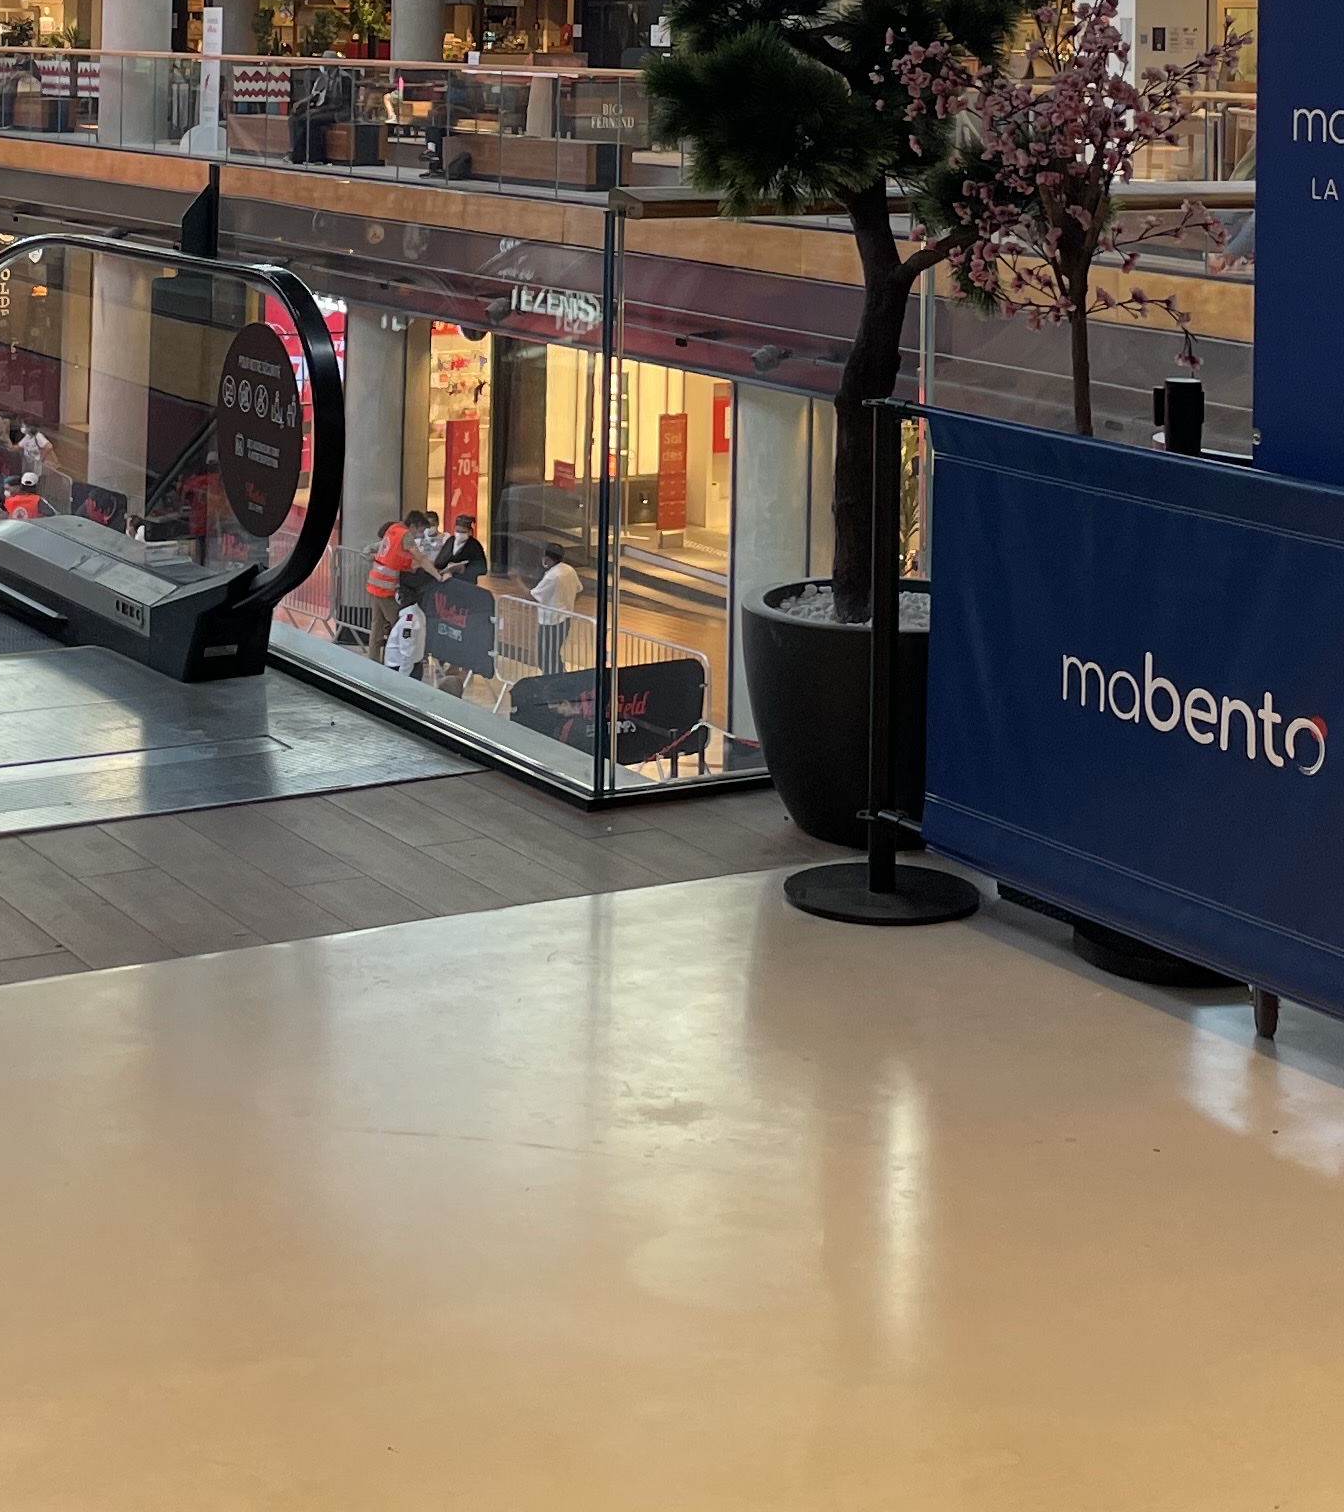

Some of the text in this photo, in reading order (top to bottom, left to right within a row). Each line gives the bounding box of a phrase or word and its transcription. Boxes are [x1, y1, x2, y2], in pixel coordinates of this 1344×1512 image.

[602, 103, 624, 116] BIG
[1311, 177, 1339, 201] LA
[1062, 651, 1327, 777] mabento
